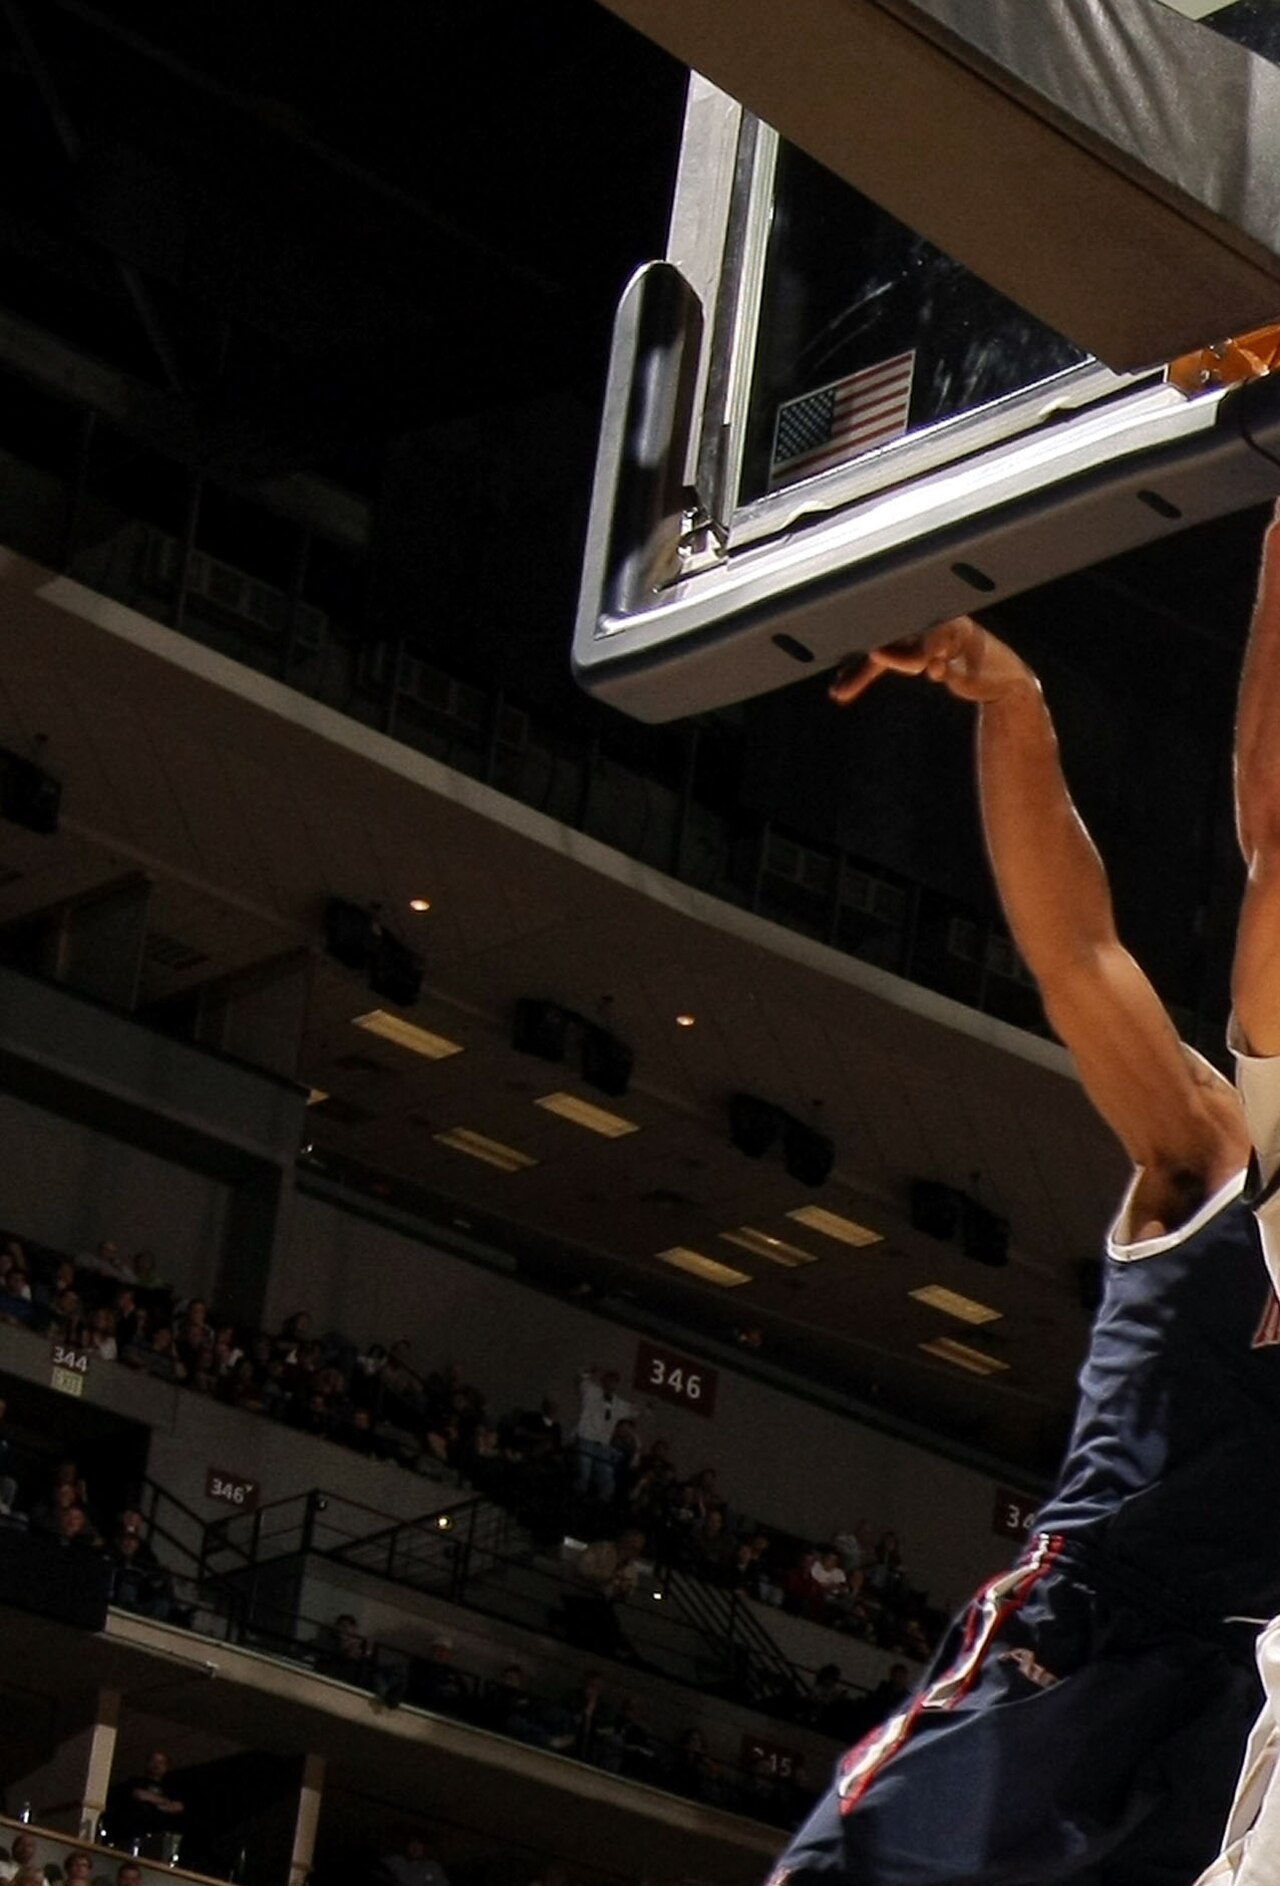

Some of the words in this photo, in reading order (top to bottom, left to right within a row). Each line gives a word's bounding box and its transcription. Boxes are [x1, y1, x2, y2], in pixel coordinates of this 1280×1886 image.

[53, 1346, 88, 1372] 344
[649, 1358, 702, 1399] 346
[211, 1477, 245, 1504] 346
